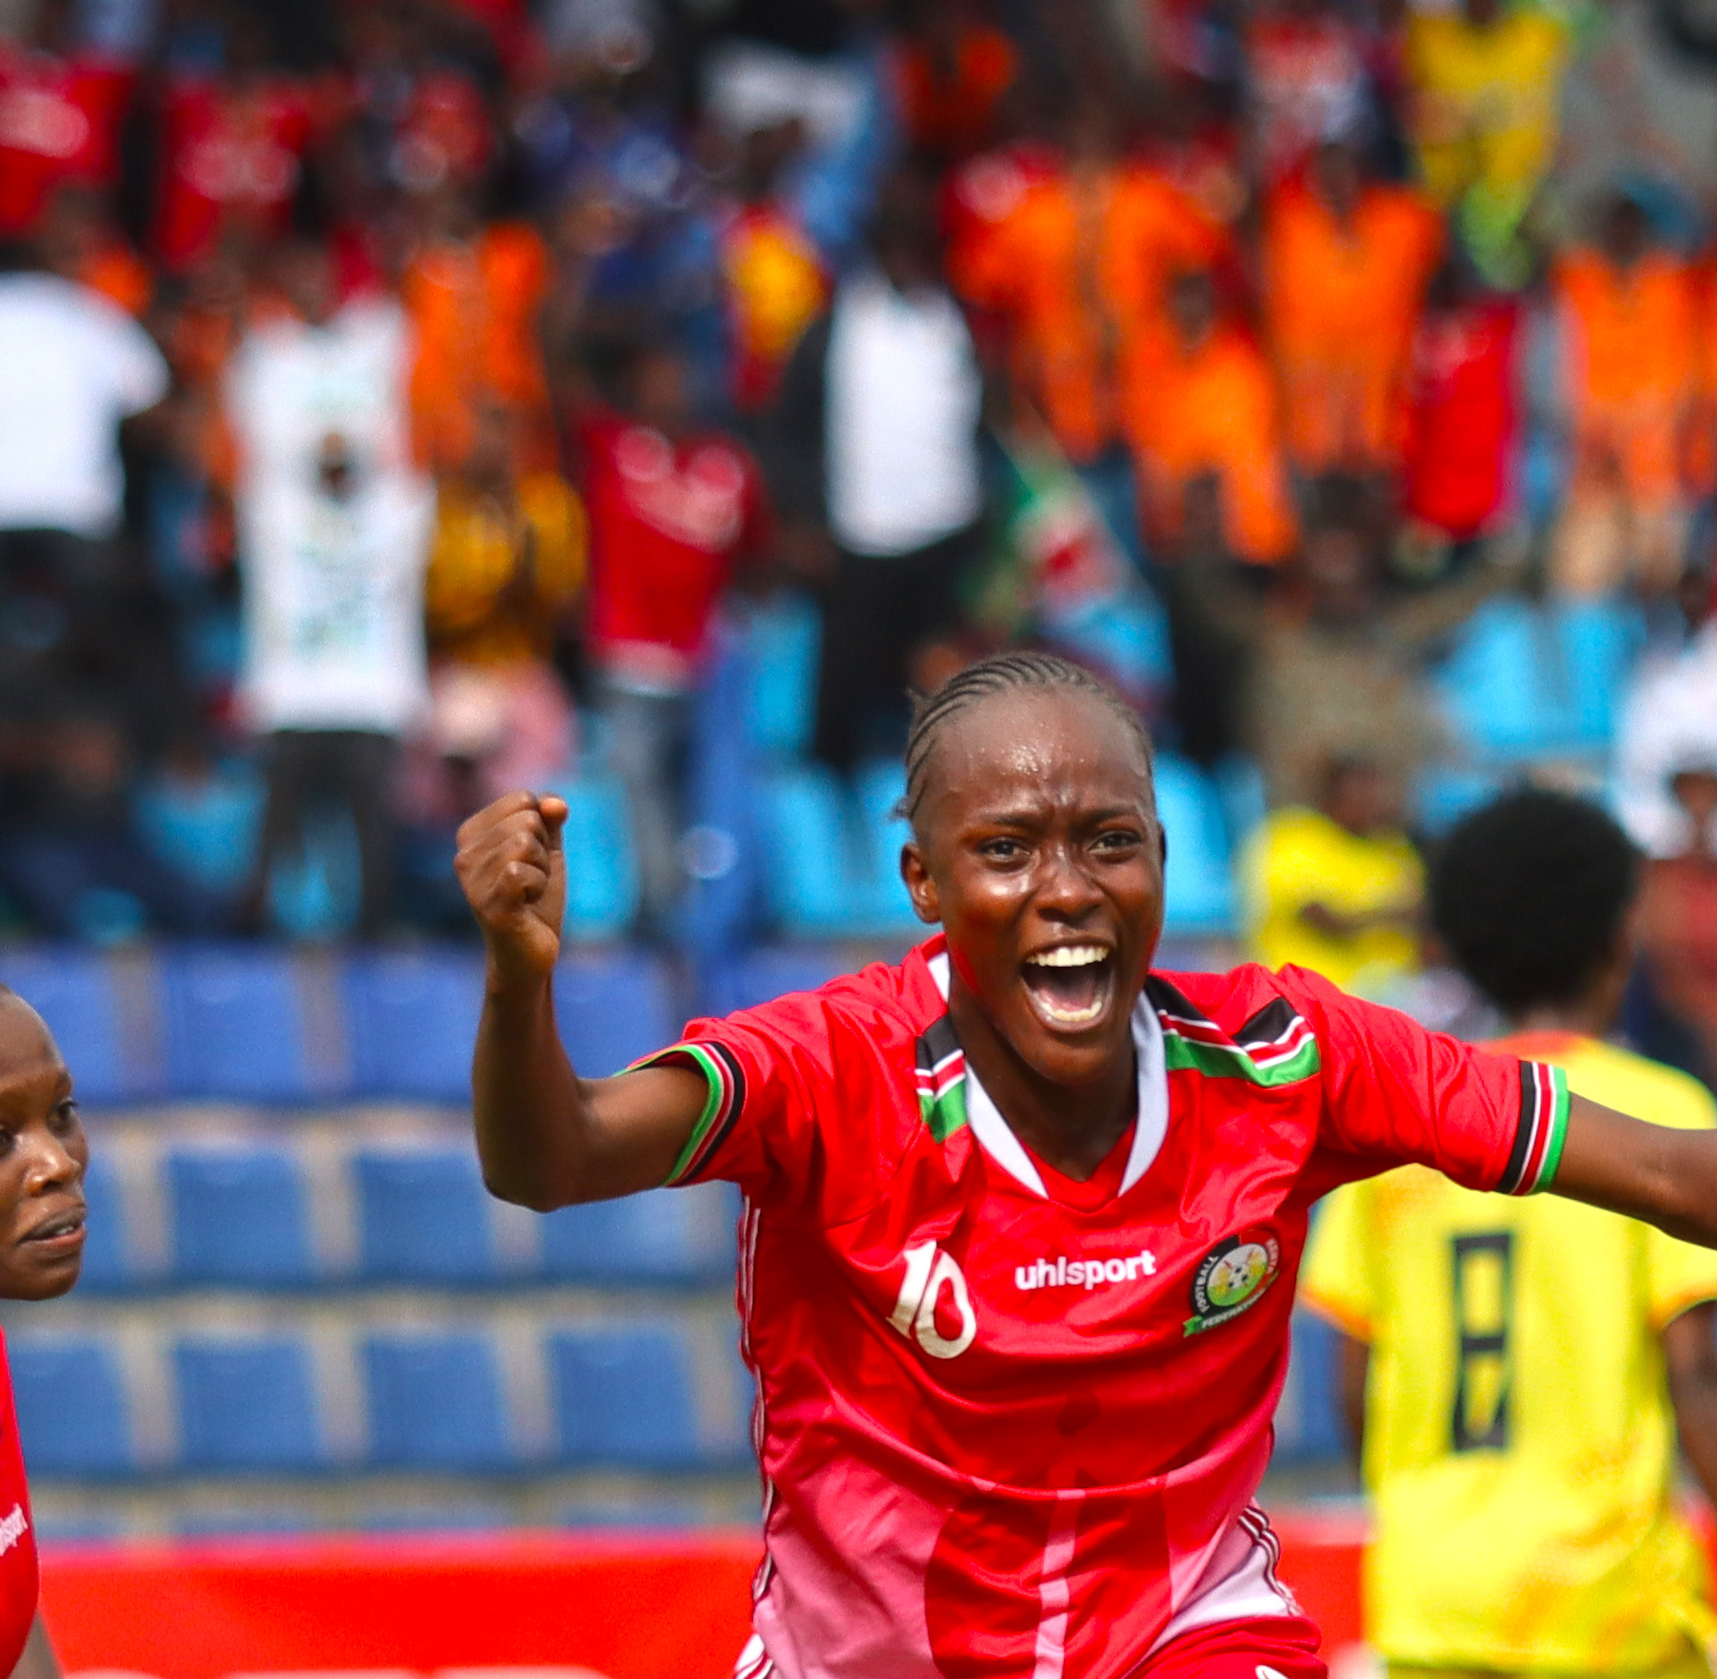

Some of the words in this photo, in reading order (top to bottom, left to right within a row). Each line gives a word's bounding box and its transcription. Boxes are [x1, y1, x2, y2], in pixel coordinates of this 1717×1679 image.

[885, 1239, 978, 1360] 10
[1014, 1249, 1157, 1291] uhlsport
[1449, 1229, 1515, 1453] 8
